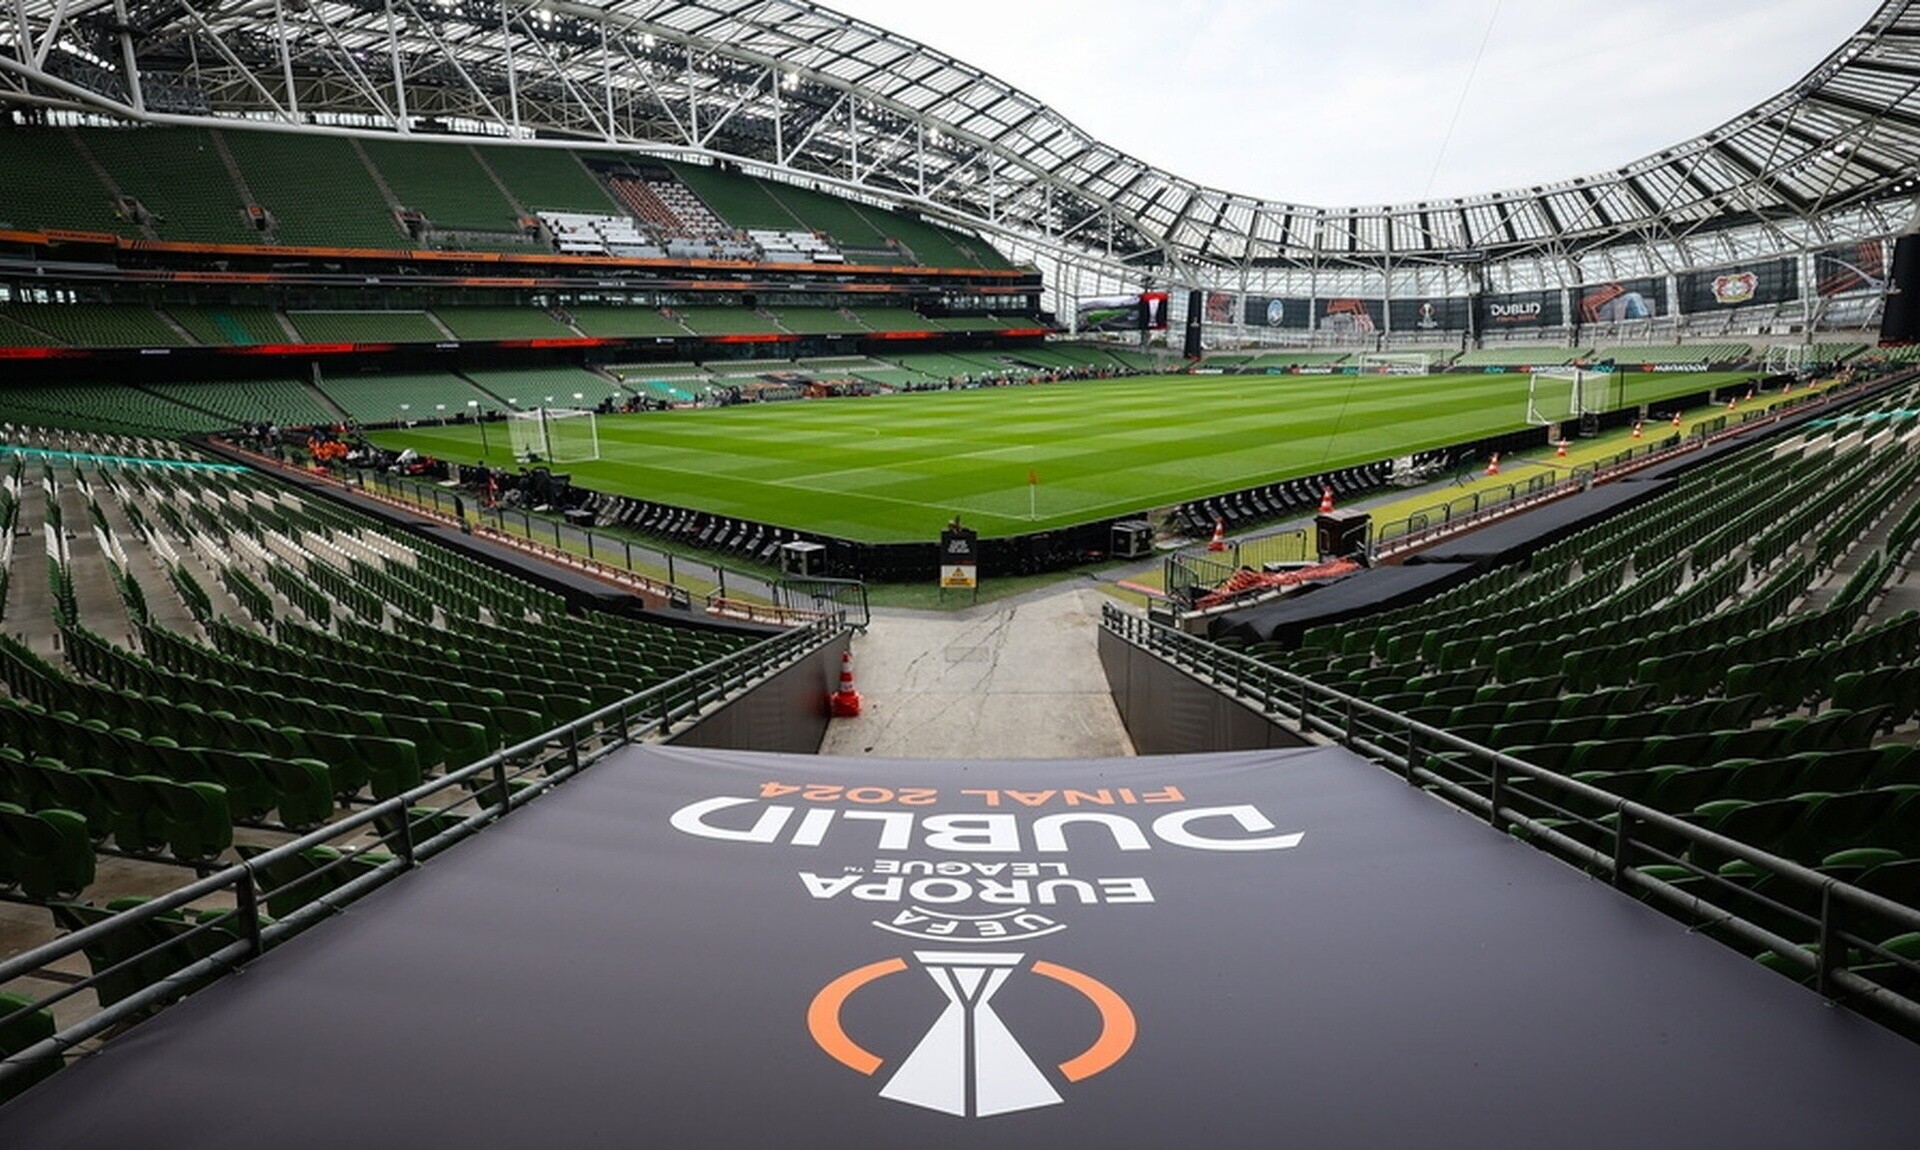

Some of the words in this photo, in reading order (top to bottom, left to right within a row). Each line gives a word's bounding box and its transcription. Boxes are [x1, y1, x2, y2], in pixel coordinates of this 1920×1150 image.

[1489, 302, 1541, 316] DUBLIN
[760, 782, 938, 805] 2024
[961, 786, 1185, 807] FINAL
[670, 797, 1305, 852] DUBLIN
[799, 871, 1155, 905] EUROPA
[892, 909, 1055, 935] UEFA
